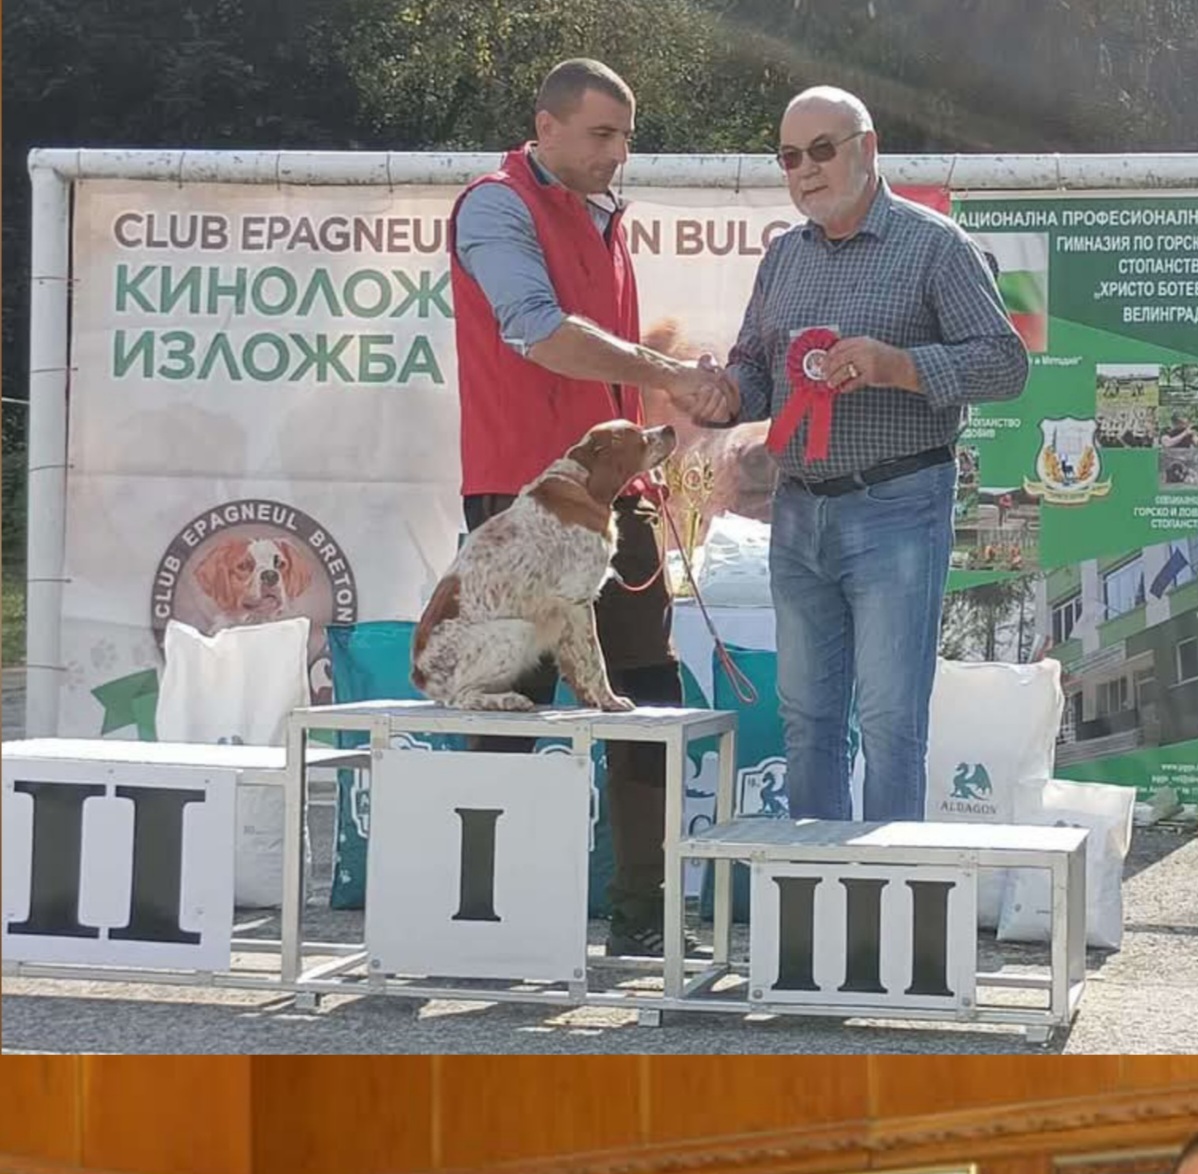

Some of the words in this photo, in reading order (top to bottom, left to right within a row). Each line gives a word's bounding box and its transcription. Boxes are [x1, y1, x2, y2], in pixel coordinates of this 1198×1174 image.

[113, 212, 229, 250] CLUB
[1056, 235, 1130, 252] ГИМНАЗИЯ
[1134, 235, 1153, 251] ПО
[111, 329, 445, 384] ИЗЛОЖБА
[154, 555, 181, 619] CLUB
[181, 503, 300, 548] EPAGNEUL
[308, 529, 353, 622] BRETON
[6, 780, 206, 946] II
[453, 807, 504, 922] I
[771, 875, 957, 997] III
